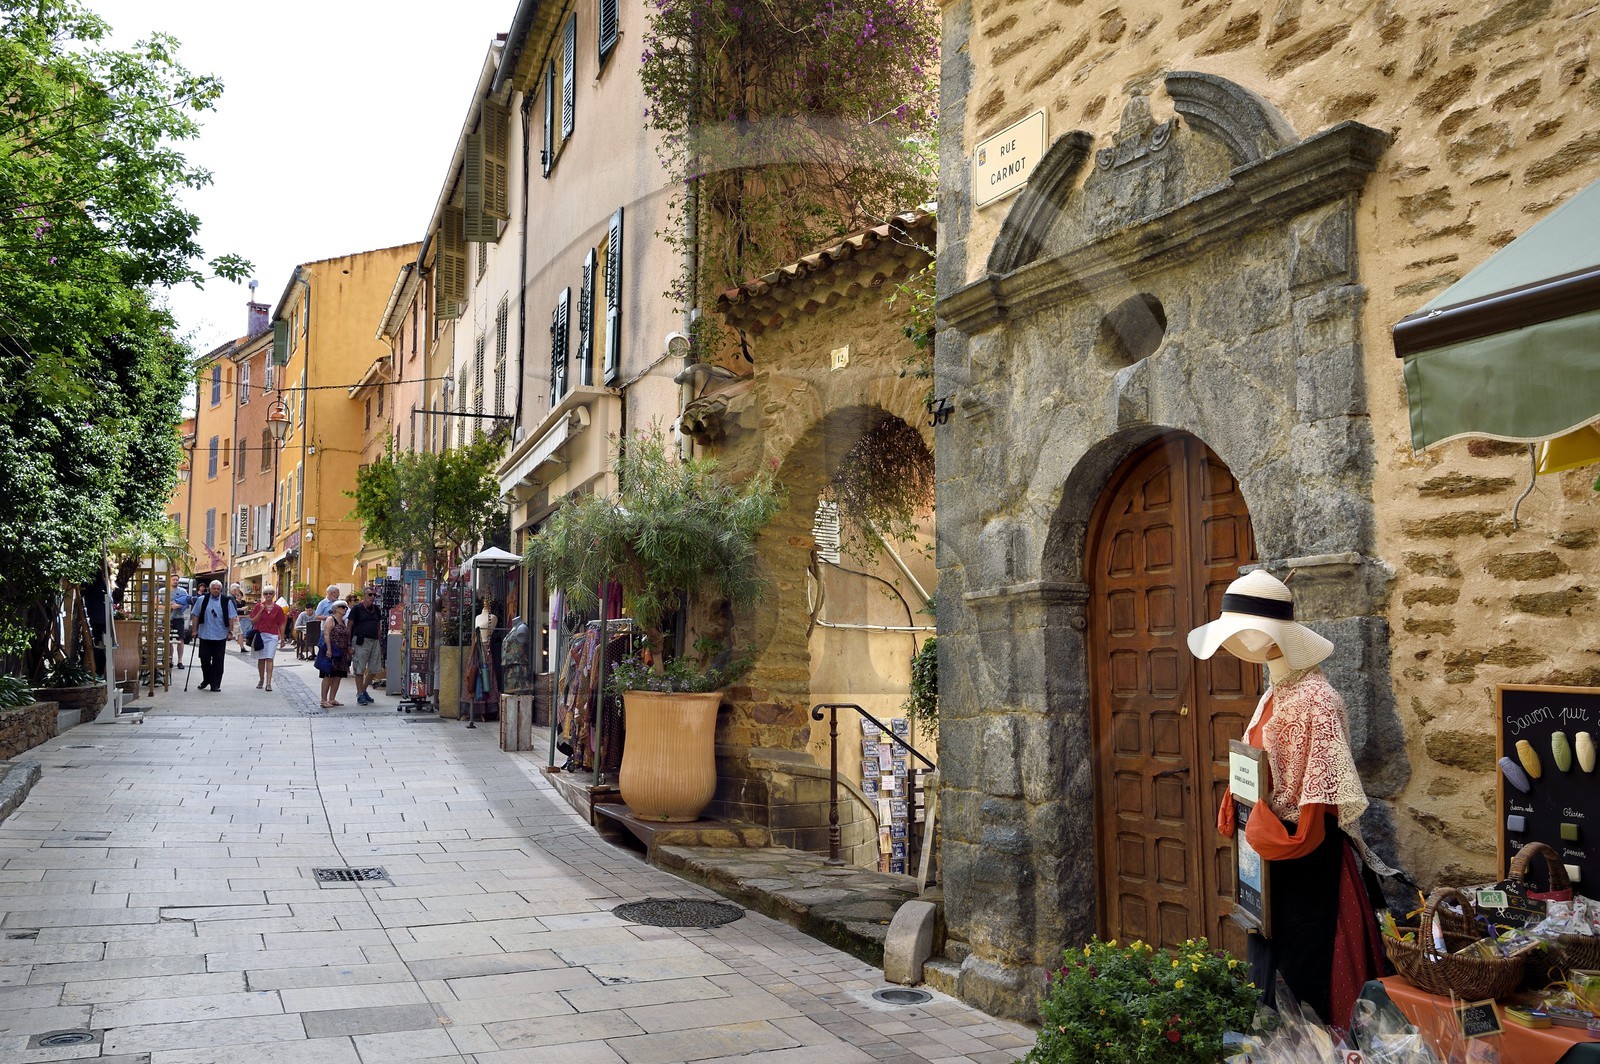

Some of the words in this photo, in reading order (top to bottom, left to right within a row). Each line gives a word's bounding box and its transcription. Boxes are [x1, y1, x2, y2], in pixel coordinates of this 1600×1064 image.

[1000, 139, 1016, 157] RUE
[990, 156, 1026, 186] CARNOT
[1506, 706, 1555, 735] Savon
[1558, 707, 1590, 726] pur
